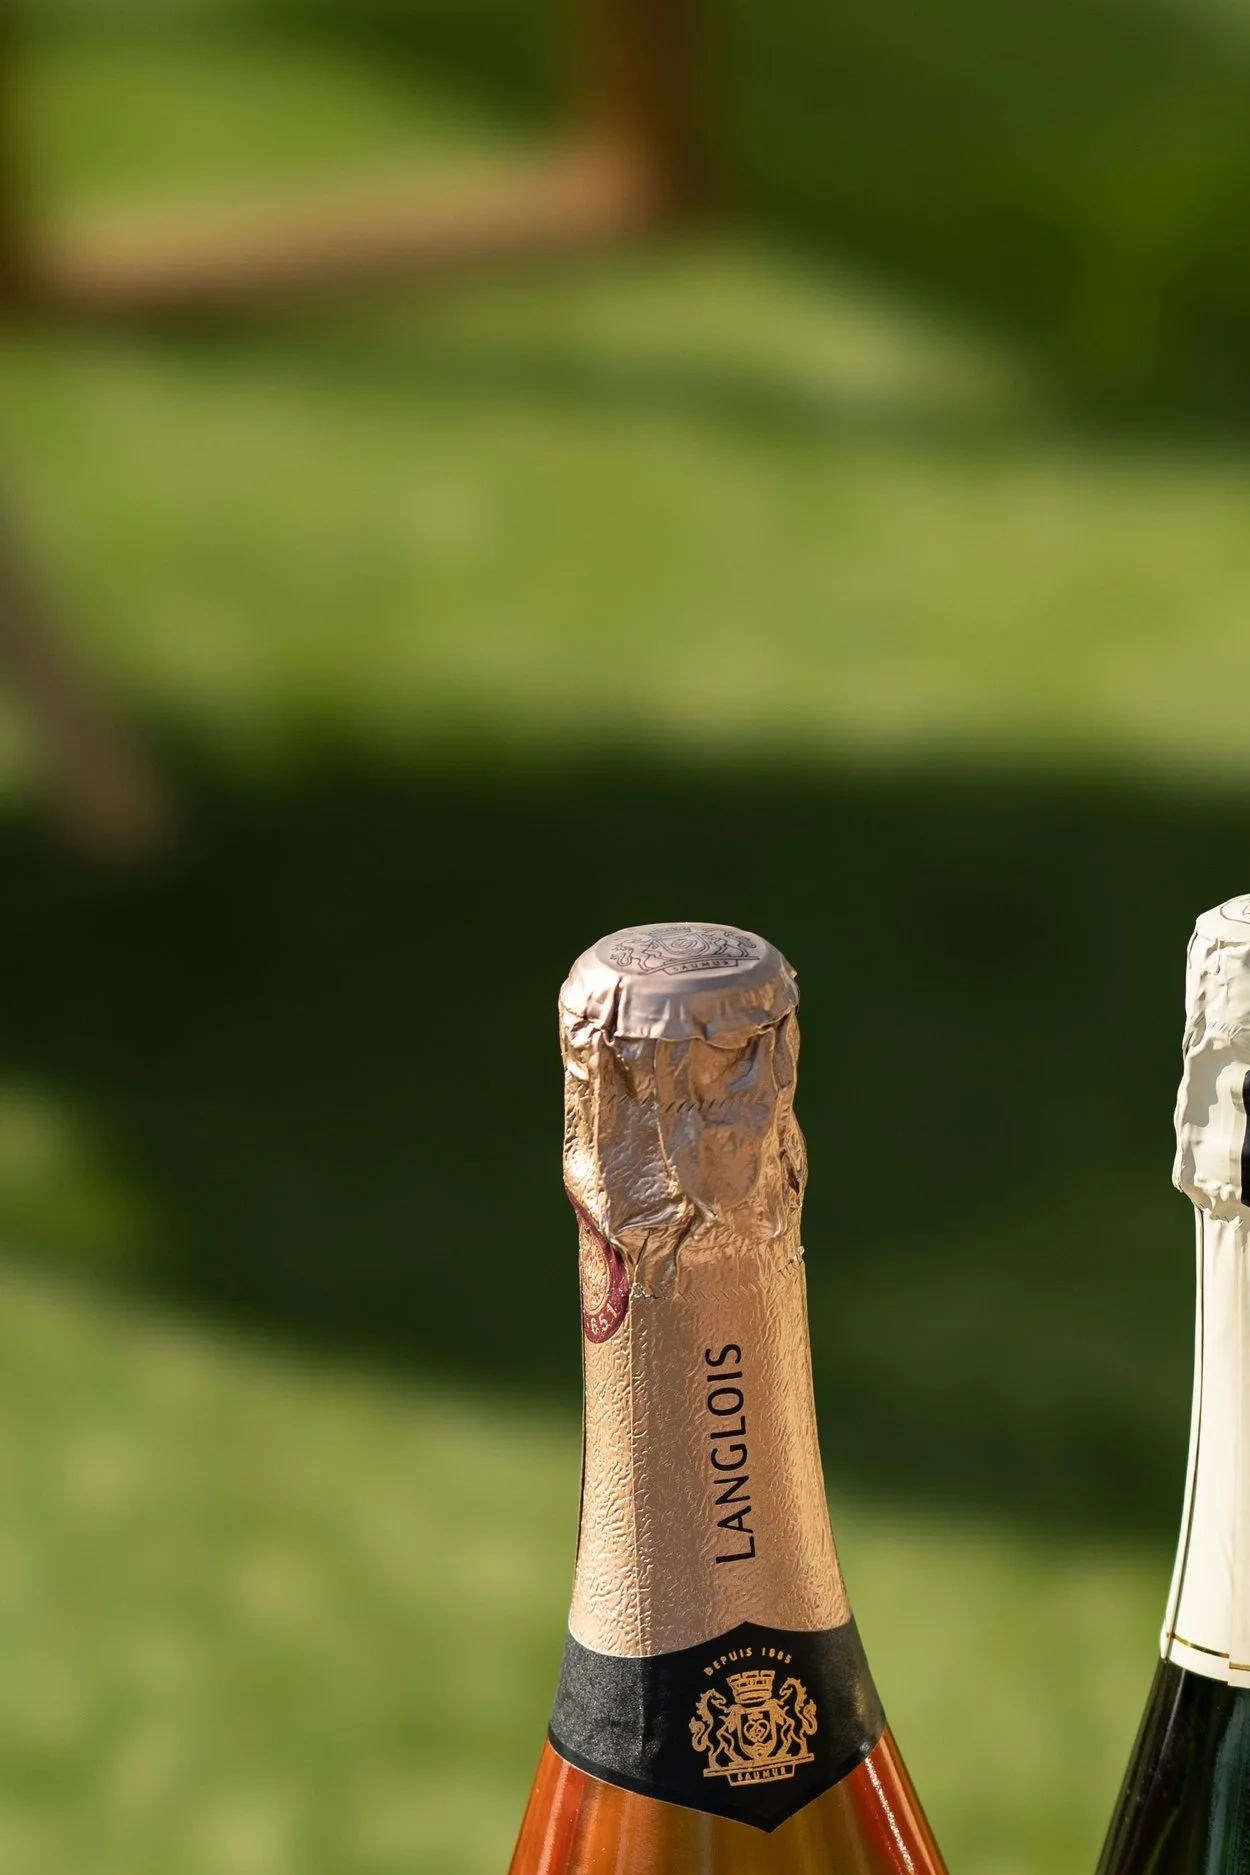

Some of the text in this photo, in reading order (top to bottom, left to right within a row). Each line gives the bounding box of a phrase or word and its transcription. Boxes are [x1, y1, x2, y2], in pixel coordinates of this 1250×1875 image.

[705, 1343, 756, 1564] LANGLOIS
[703, 1647, 793, 1677] DEPUIS 1885
[737, 1766, 787, 1782] SAUMUR
